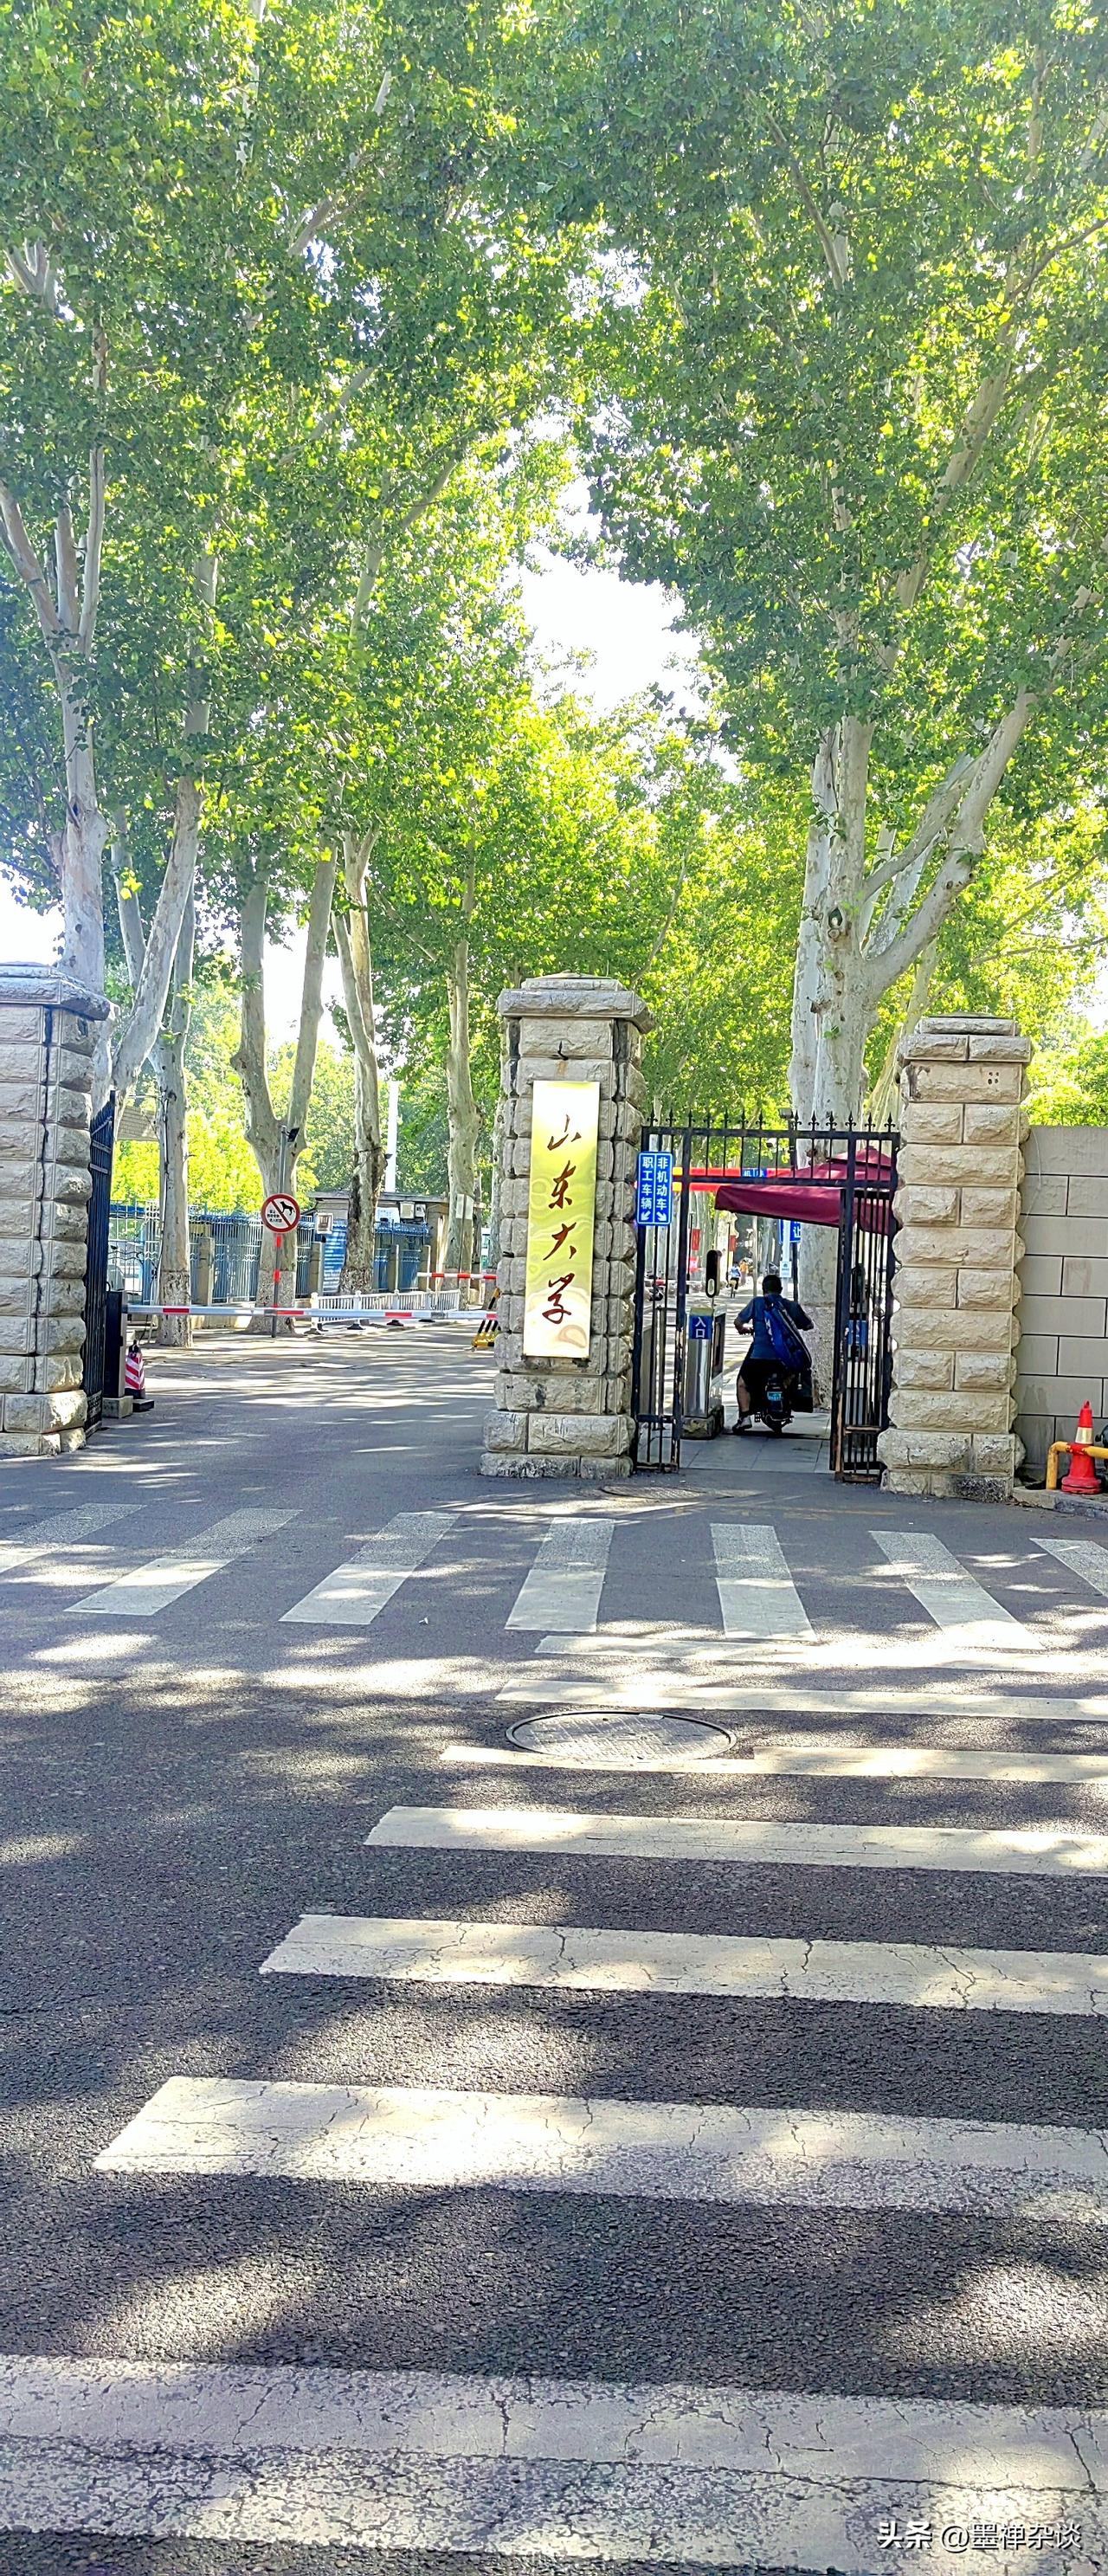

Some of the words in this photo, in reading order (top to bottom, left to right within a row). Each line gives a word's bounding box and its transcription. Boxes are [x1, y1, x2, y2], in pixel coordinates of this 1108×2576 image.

[641, 1157, 654, 1210] 职工车辆
[655, 1157, 668, 1211] 非机动车
[542, 1114, 582, 1325] 山东大学
[694, 1316, 706, 1338] 入口
